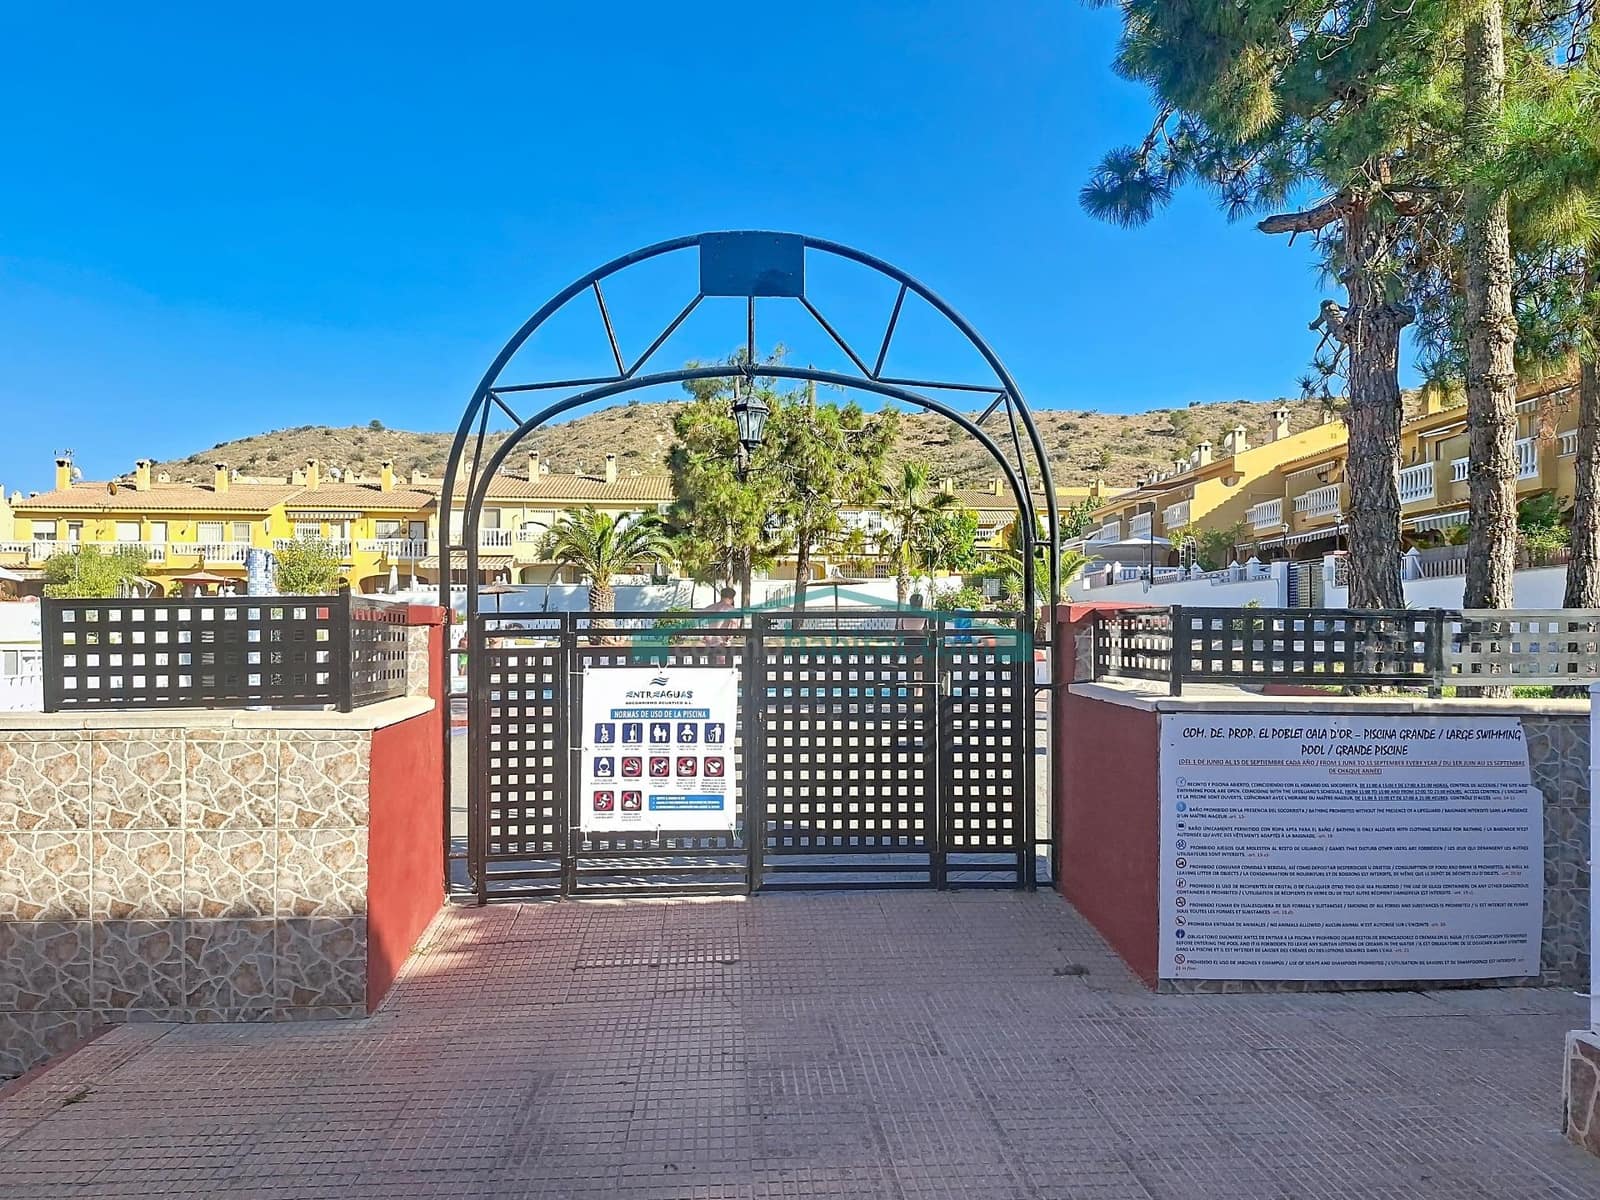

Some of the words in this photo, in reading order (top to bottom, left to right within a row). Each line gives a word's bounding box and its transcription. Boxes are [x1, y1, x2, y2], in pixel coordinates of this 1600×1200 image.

[625, 690, 693, 699] ENTREAGUAS
[615, 710, 639, 719] NORMAS
[641, 710, 649, 719] DE
[650, 710, 662, 719] USO
[664, 710, 672, 719] DE
[674, 710, 681, 719] LA
[683, 710, 706, 719] PISCINA
[1183, 728, 1206, 738] COM.
[1210, 728, 1225, 739] DE.
[1229, 728, 1255, 739] PROP.
[1258, 728, 1269, 739] EL
[1271, 728, 1303, 739] POBLET
[1306, 728, 1327, 739] CALA
[1330, 728, 1352, 739] D'OR
[1364, 728, 1397, 740] PISCINA
[1399, 728, 1436, 740] GRANDE
[1446, 728, 1474, 741] LARGE
[1476, 728, 1521, 741] SWIMMING
[1301, 744, 1326, 756] POOL
[1336, 744, 1372, 756] GRANDE
[1374, 744, 1409, 756] PISCINE
